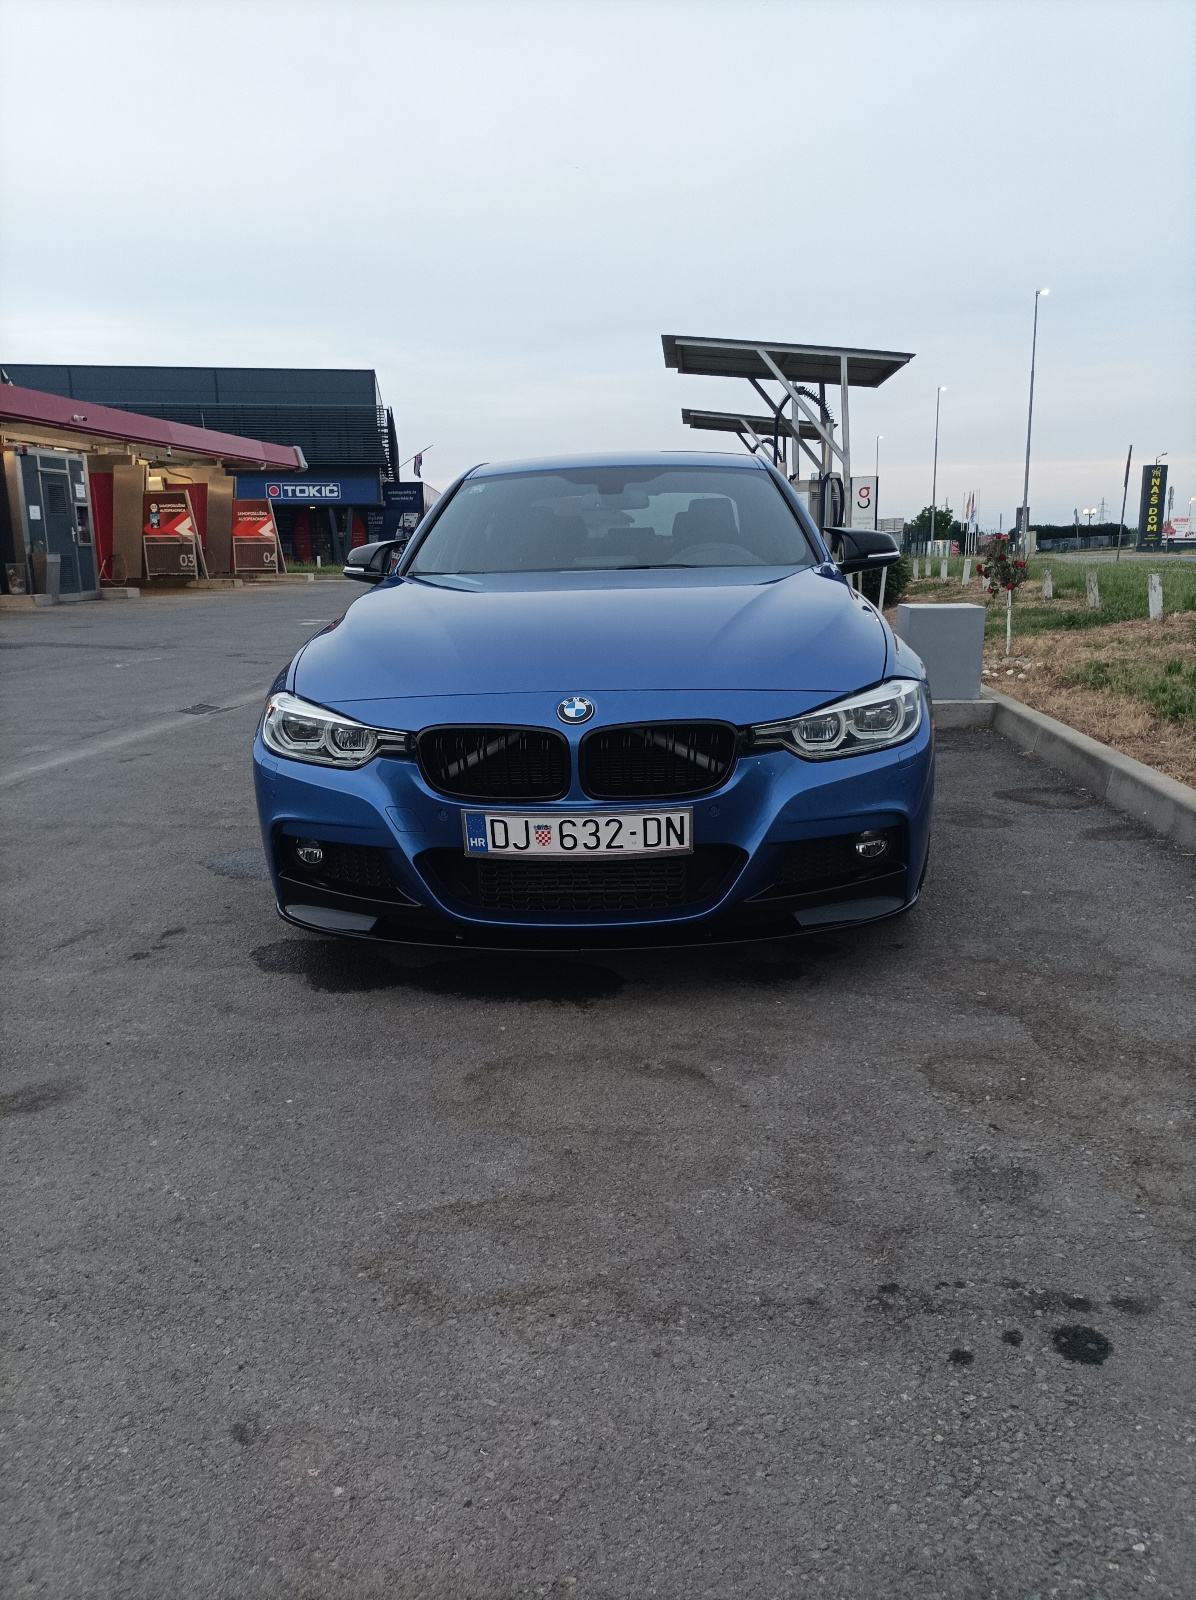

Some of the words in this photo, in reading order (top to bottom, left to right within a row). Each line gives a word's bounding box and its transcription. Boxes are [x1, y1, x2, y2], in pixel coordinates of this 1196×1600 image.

[284, 484, 339, 497] TOKIĆ
[1151, 478, 1160, 504] NAŠ
[1147, 508, 1158, 531] DOM
[180, 554, 195, 566] 03
[263, 552, 277, 563] 04
[490, 818, 531, 851] DJ
[469, 837, 486, 848] HR
